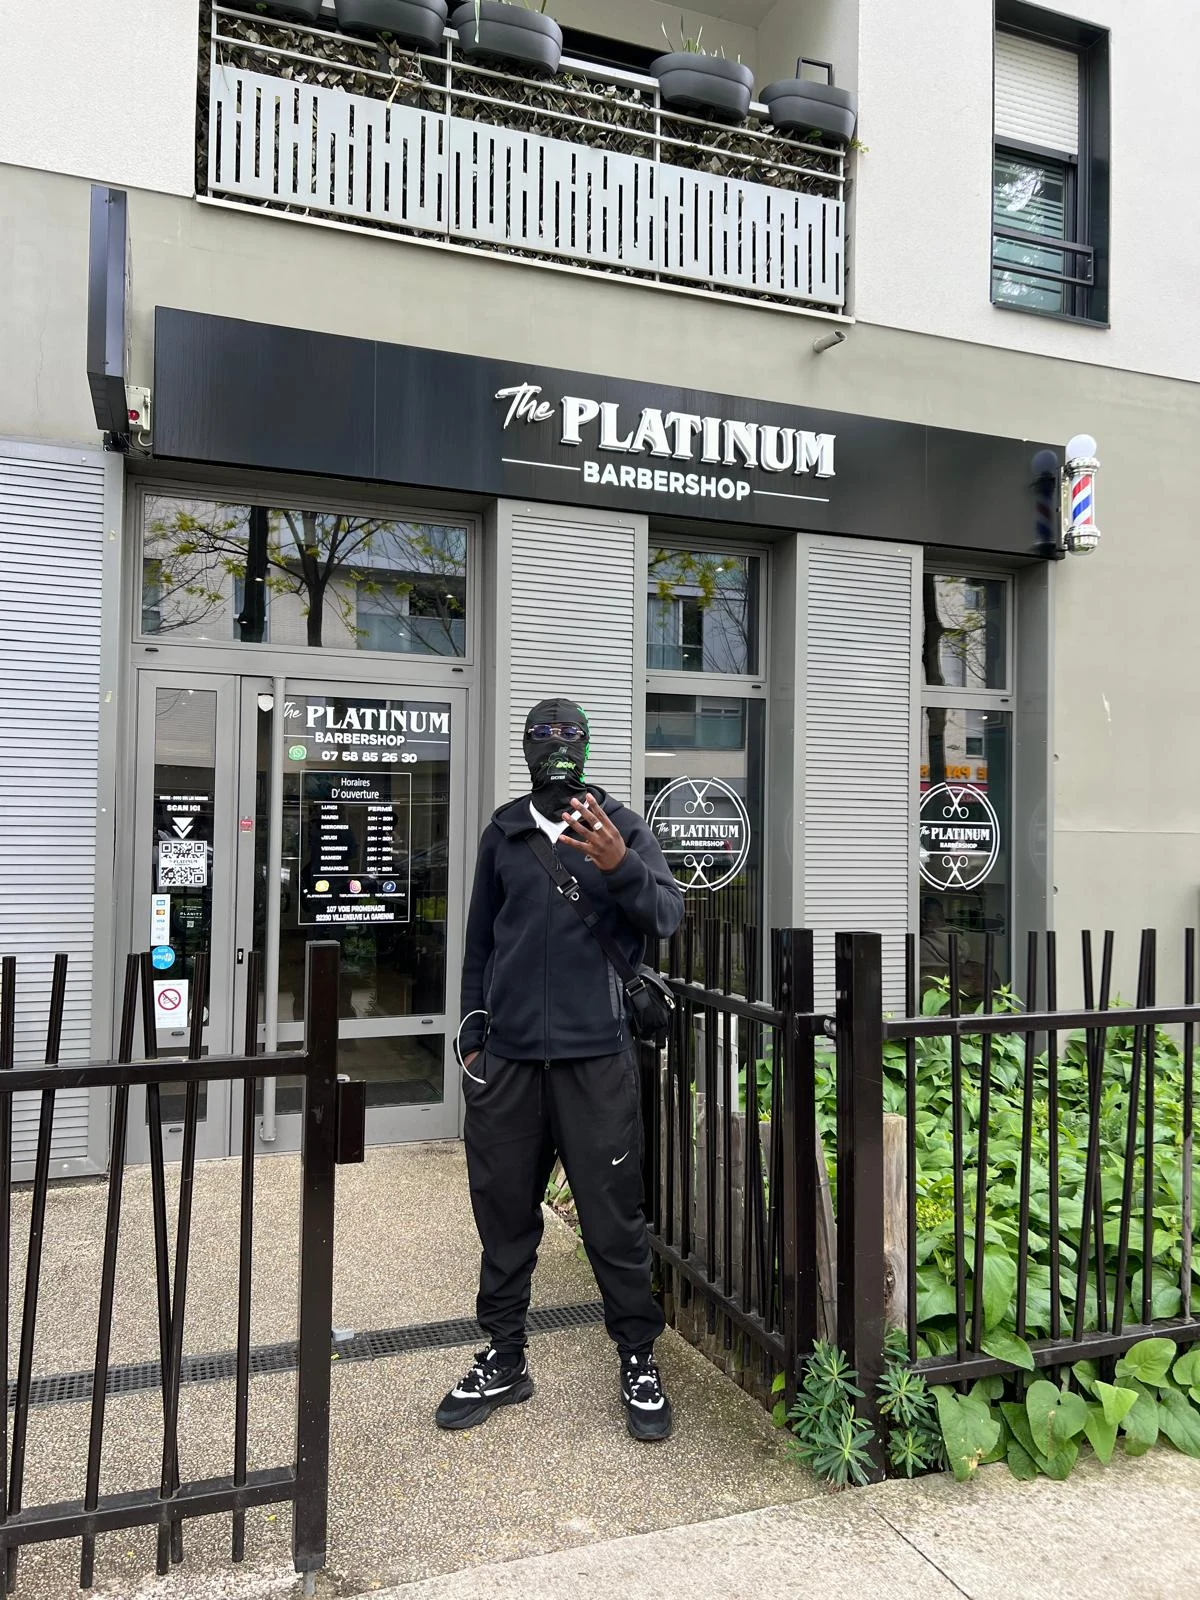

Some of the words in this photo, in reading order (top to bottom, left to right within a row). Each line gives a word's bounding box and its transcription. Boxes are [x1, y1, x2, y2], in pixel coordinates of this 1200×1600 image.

[495, 382, 555, 430] The
[560, 395, 837, 478] PLATINUM
[583, 461, 751, 501] BARBERSHOP
[305, 705, 450, 734] PLATINUM
[315, 732, 406, 747] BARBERSHOP
[321, 751, 339, 761] 07
[341, 751, 359, 761] 58
[362, 752, 379, 762] 85
[381, 752, 398, 762] 26
[401, 753, 418, 763] 30
[341, 778, 371, 787] Horaires
[656, 822, 669, 835] The
[671, 824, 739, 838] PLATINUM
[931, 827, 990, 840] PLATINUM
